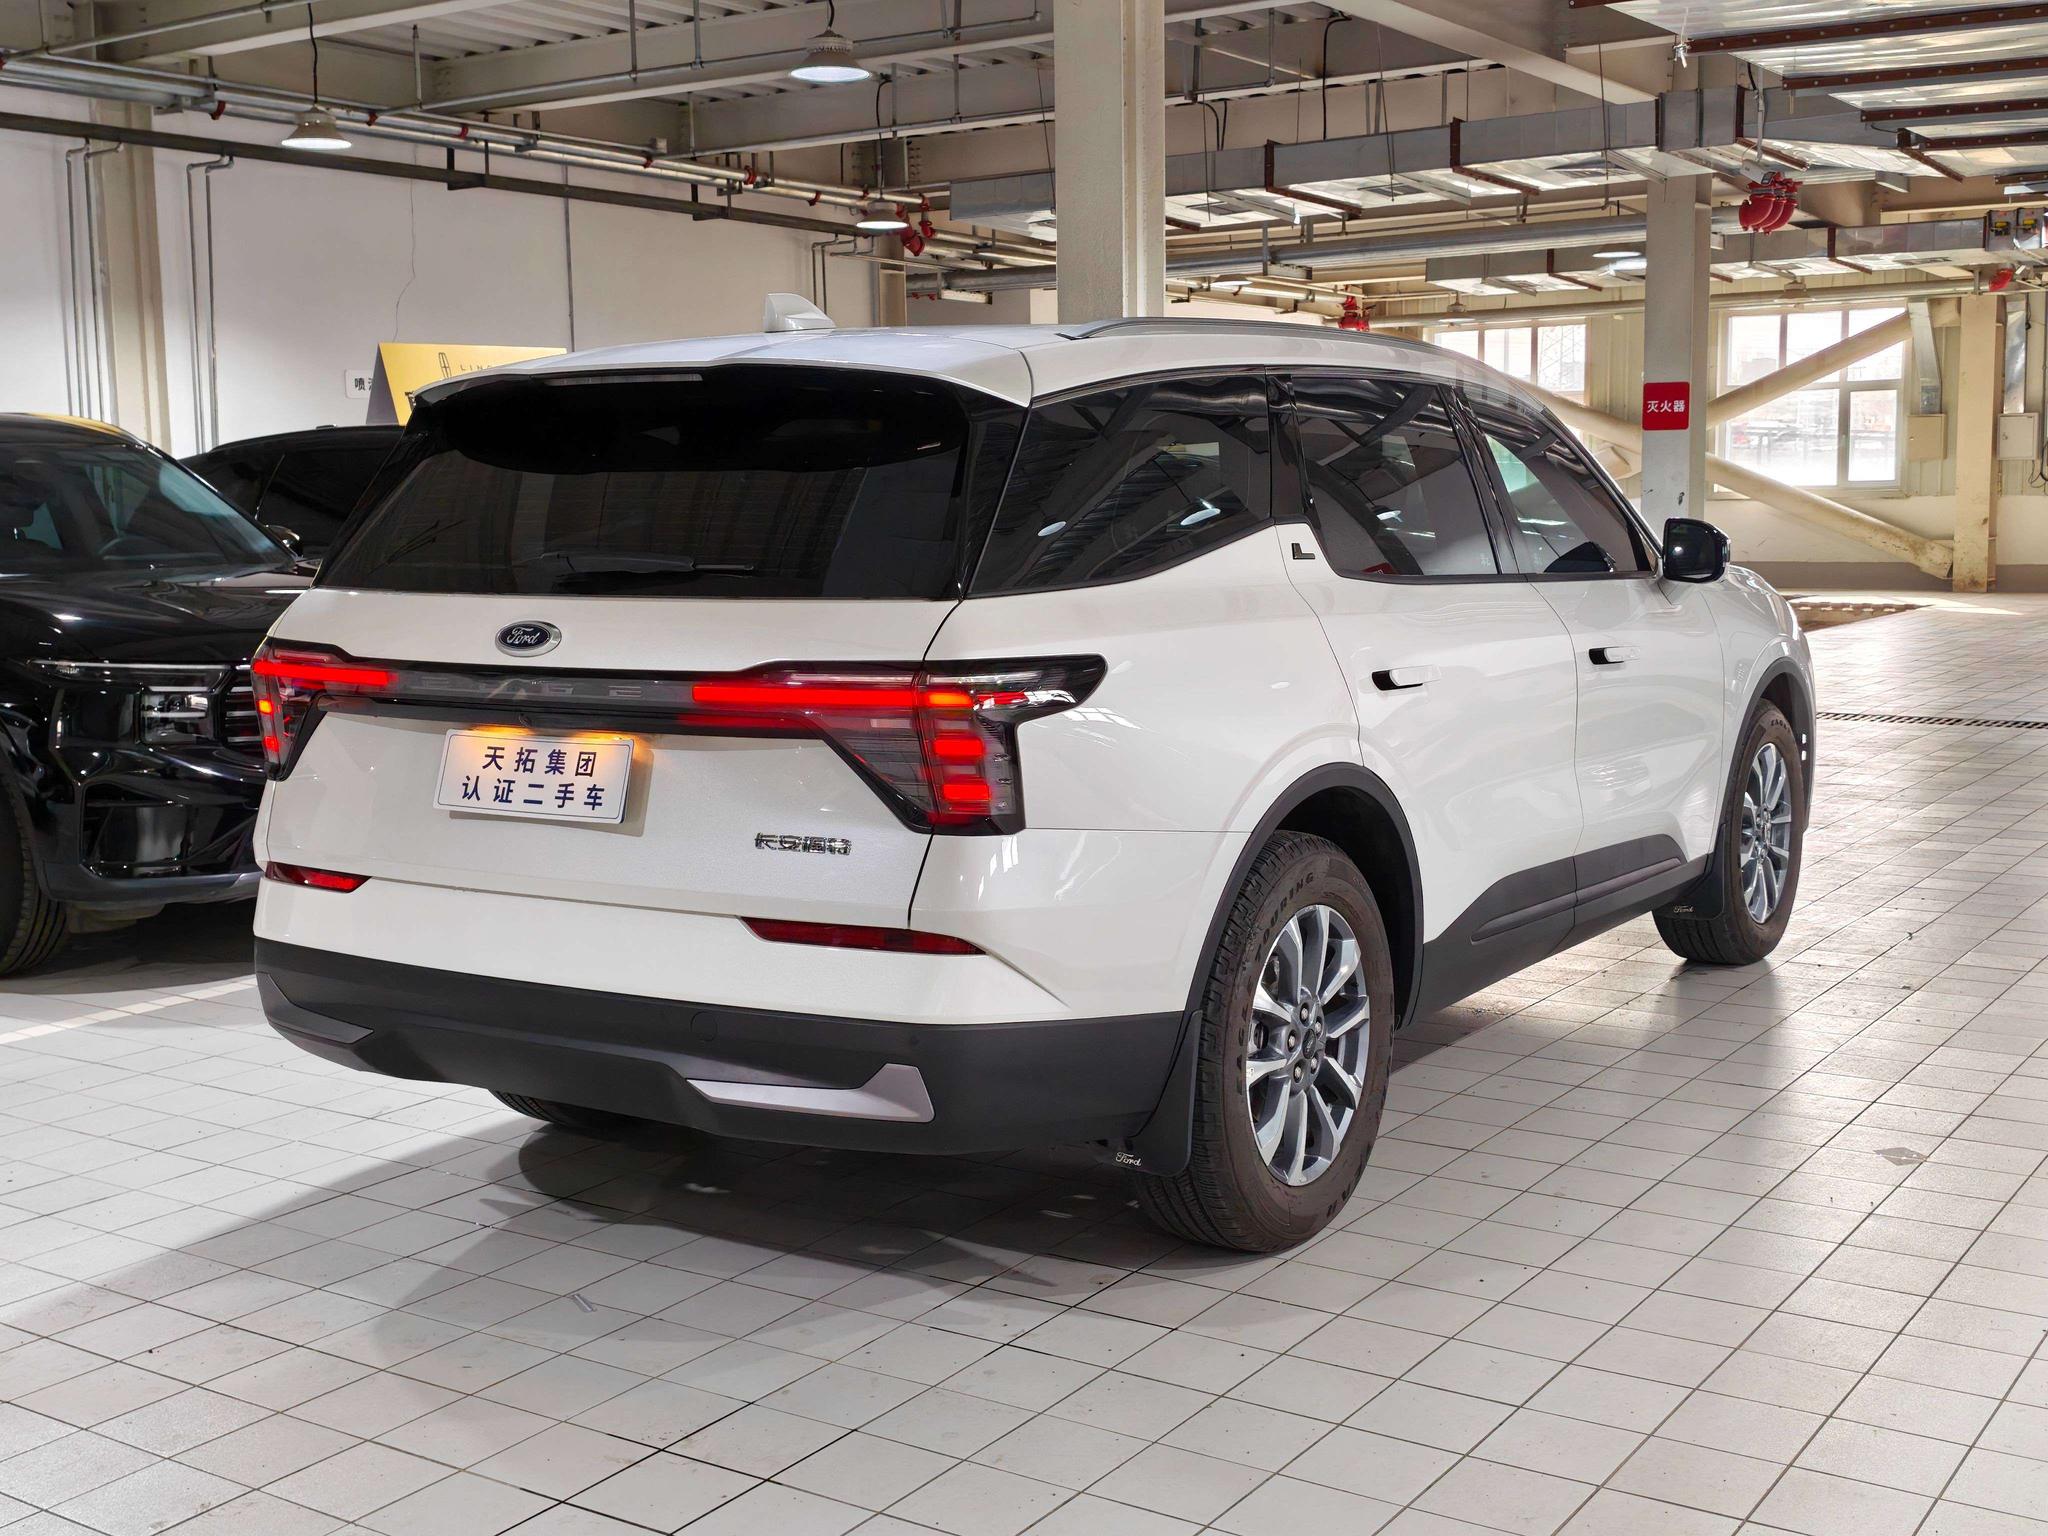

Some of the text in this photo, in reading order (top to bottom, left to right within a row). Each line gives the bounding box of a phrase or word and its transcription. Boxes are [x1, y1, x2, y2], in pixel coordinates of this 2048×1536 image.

[1647, 400, 1685, 413] 灭火器
[506, 626, 541, 645] Ford
[482, 745, 597, 777] 天拓集团
[462, 775, 605, 811] 认证二手车
[1115, 1151, 1142, 1167] Ford
